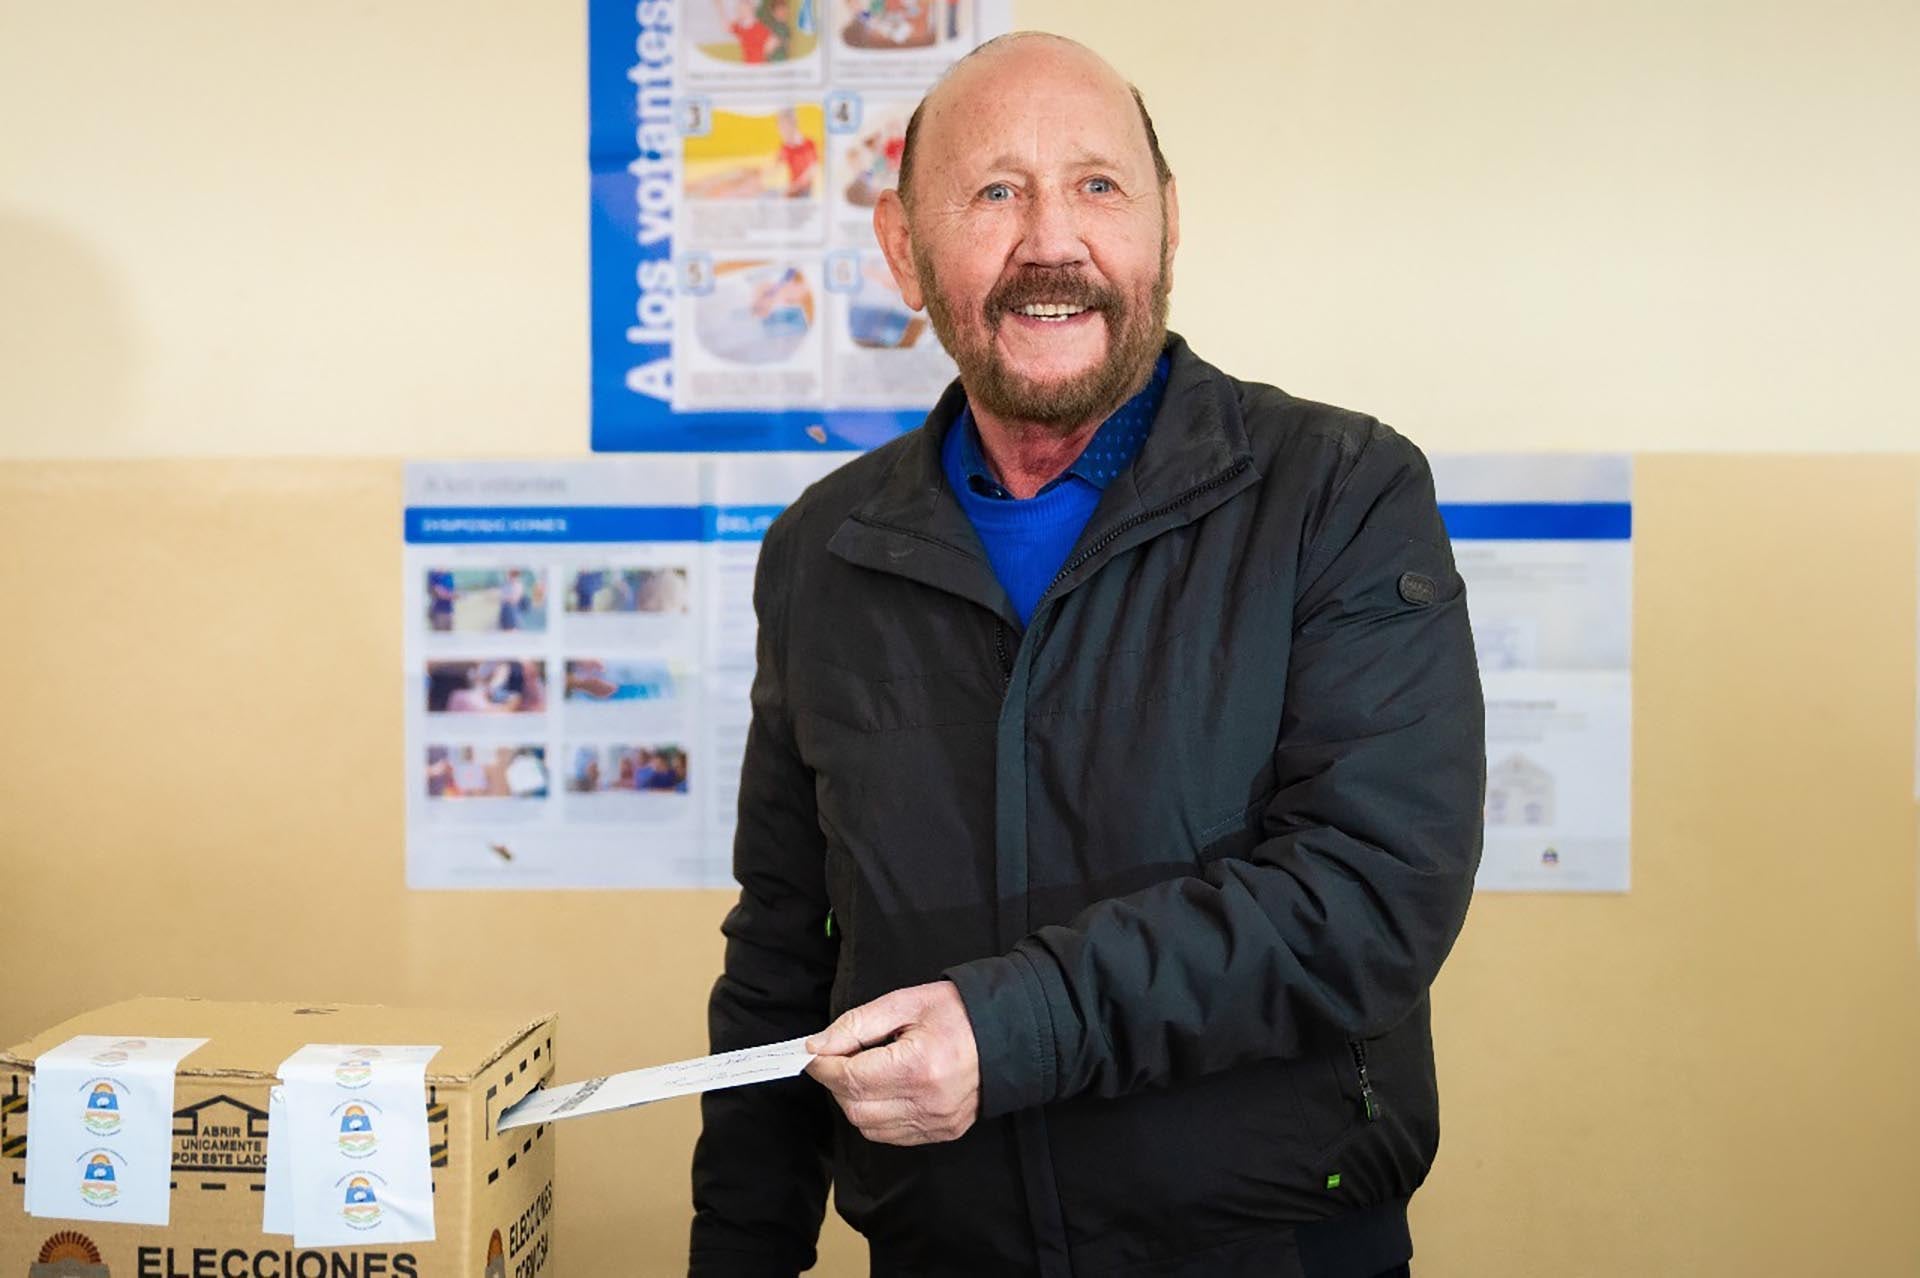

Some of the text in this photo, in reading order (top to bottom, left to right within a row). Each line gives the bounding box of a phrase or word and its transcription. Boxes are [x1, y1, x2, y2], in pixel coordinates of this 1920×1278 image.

[687, 102, 702, 125] 3
[834, 101, 849, 122] 4
[626, 0, 674, 401] A los votantes
[422, 517, 567, 533] DISPOSICIONES
[202, 1126, 241, 1137] ABRIR
[181, 1139, 262, 1152] UNICAMENTE
[171, 1152, 199, 1164] POR
[202, 1153, 233, 1165] ESTE
[509, 1179, 552, 1259] ELECCIONES
[136, 1246, 418, 1278] ELECCIONES
